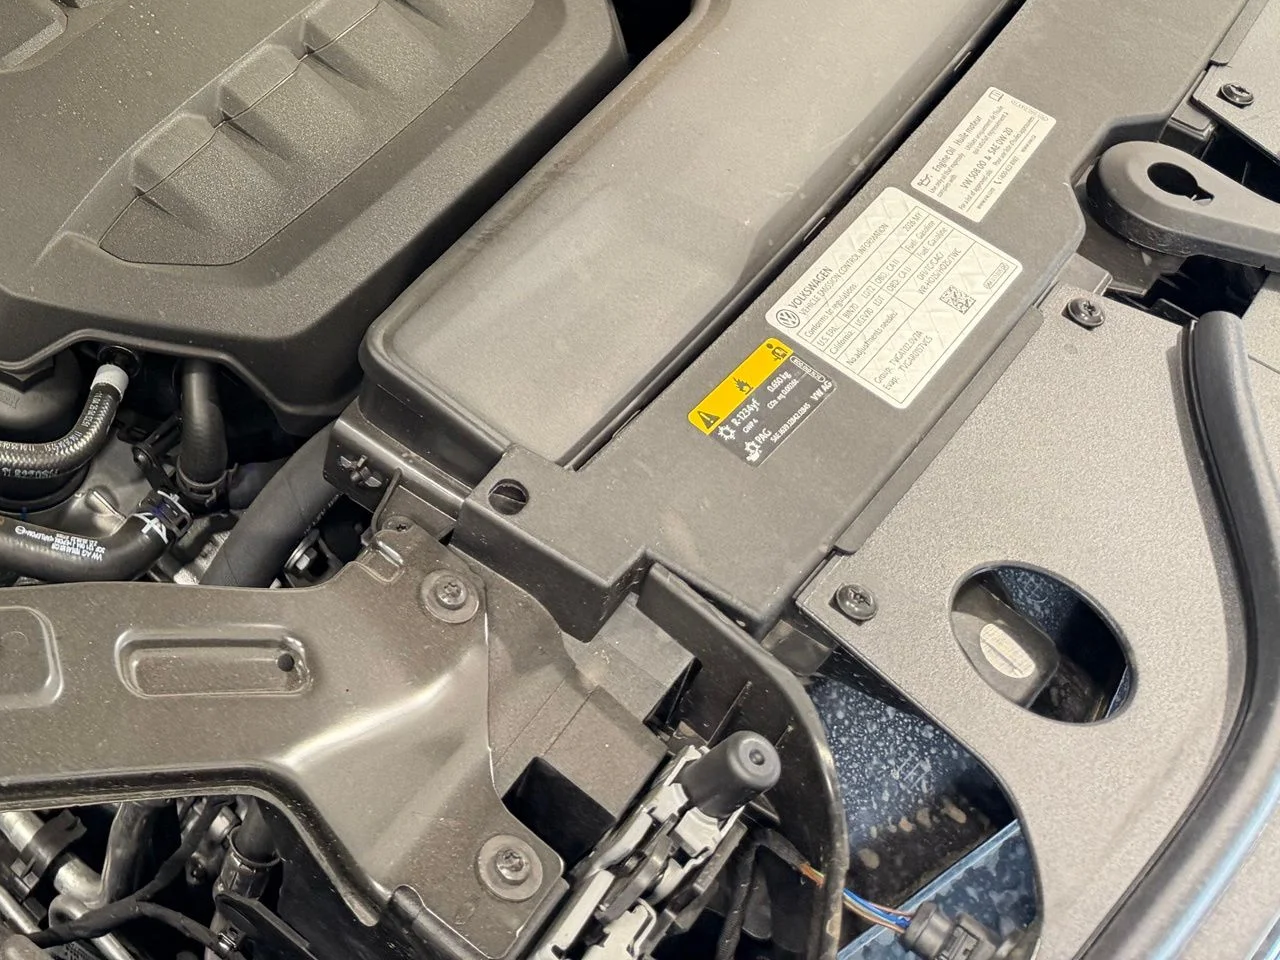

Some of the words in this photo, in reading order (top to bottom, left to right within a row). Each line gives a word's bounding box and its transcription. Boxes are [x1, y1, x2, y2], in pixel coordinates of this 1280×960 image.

[932, 154, 951, 172] Engine
[944, 146, 956, 155] Oil
[959, 176, 973, 189] VW
[987, 143, 1000, 155] SAE
[799, 295, 820, 315] VEHICLE
[817, 273, 841, 296] EMISSION
[838, 253, 859, 274] CONTROL
[857, 223, 888, 254] INFORMATION
[789, 266, 832, 309] VOLKSWAGEN
[804, 314, 828, 337] Conforms
[766, 377, 783, 392] 0.650
[778, 369, 792, 381] kg
[810, 388, 824, 400] VW
[819, 379, 833, 392] AG
[730, 398, 762, 427] R-1234yf
[754, 428, 771, 443] PAG
